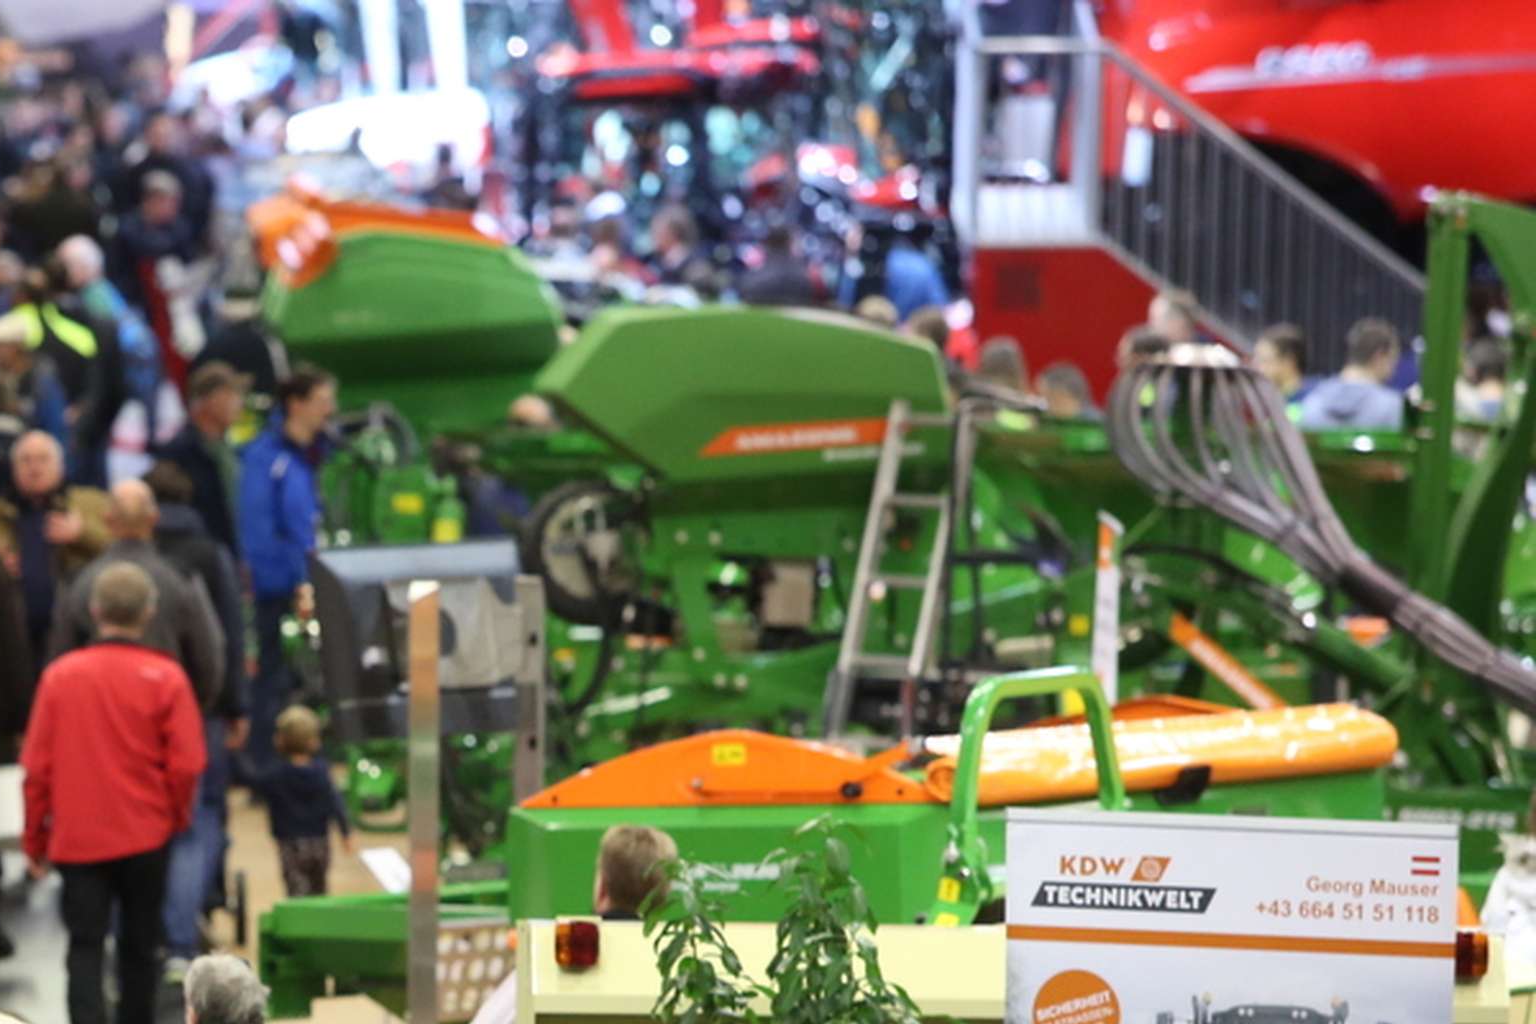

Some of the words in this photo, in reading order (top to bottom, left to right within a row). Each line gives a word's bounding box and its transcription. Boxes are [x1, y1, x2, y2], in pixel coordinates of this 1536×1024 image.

[1058, 855, 1125, 876] KDW
[1043, 885, 1204, 910] TECHNIKWELT
[1305, 875, 1363, 897] Georg
[1369, 878, 1439, 897] Mauser
[1256, 899, 1292, 918] +43
[1299, 900, 1335, 919] 664
[1342, 902, 1363, 920] 51
[1373, 903, 1394, 921] 51
[1406, 905, 1440, 924] 118
